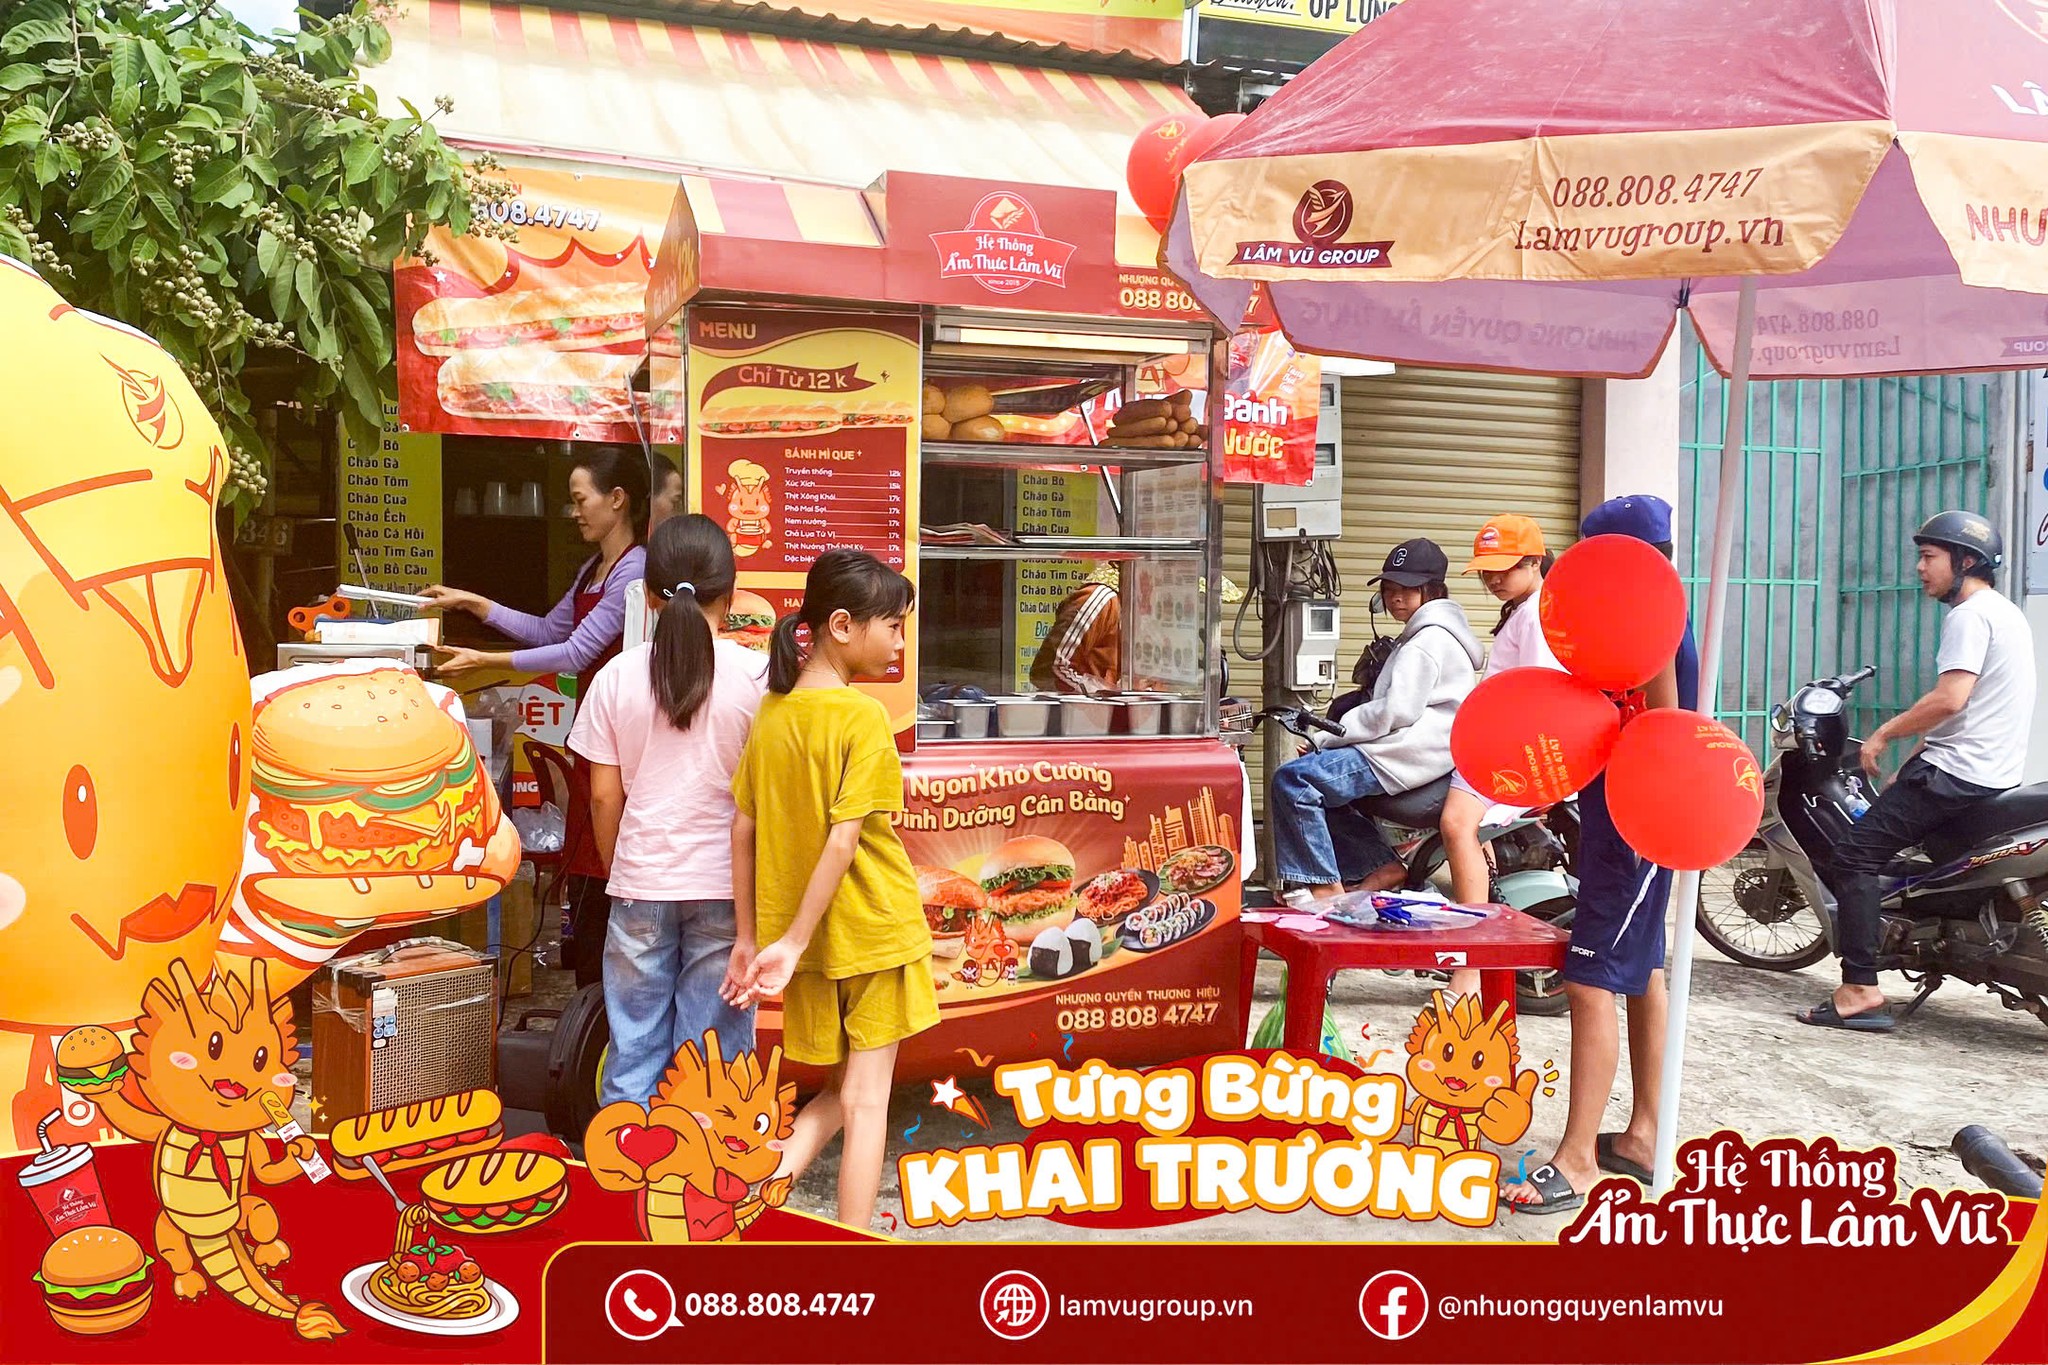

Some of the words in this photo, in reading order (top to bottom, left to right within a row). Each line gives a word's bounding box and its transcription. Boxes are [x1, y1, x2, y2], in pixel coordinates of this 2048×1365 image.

[1553, 167, 1764, 208] 088.808.4747
[1514, 216, 1785, 257] Lamvugroup.vn
[976, 234, 995, 251] Hệ
[997, 237, 1034, 257] Thống
[1243, 243, 1281, 262] LÂM
[1289, 246, 1315, 264] VŨ
[1318, 248, 1380, 265] GROUP
[973, 253, 1008, 273] Thực
[1009, 257, 1042, 275] Lâm
[1043, 260, 1063, 279] Vũ
[1120, 288, 1162, 309] 088
[700, 320, 757, 339] MENU
[738, 365, 772, 385] Chỉ
[776, 368, 804, 388] Từ
[785, 447, 816, 460] BÁNH
[818, 448, 830, 460] MÌ
[832, 450, 855, 461] QUE
[348, 456, 378, 468] Cháo
[384, 456, 399, 469] Gà
[348, 474, 378, 486] Cháo
[384, 475, 409, 487] Tôm
[1024, 475, 1048, 486] Cháo
[1052, 476, 1065, 486] Bò
[348, 492, 378, 504] Cháo
[384, 493, 407, 505] Cua
[1023, 490, 1048, 502] Cháo
[1052, 491, 1064, 502] Gà
[348, 509, 378, 522] Cháo
[384, 507, 406, 523] Ếch
[1023, 506, 1047, 518] Cháo
[1051, 507, 1071, 518] Tôm
[384, 527, 399, 539] Cá
[404, 527, 424, 540] Hồi
[1022, 522, 1047, 533] Cháo
[1051, 523, 1070, 534] Cua
[384, 545, 406, 557] Tim
[410, 546, 434, 559] Gan
[1393, 548, 1408, 567] C
[384, 562, 400, 575] Bồ
[404, 563, 428, 575] Câu
[1022, 569, 1046, 580] Cháo
[1049, 569, 1067, 580] Tim
[1021, 584, 1046, 595] Cháo
[1050, 584, 1063, 595] Bồ
[1020, 602, 1036, 613] Cháo
[1038, 602, 1050, 613] Cút
[796, 629, 808, 637] ger
[910, 773, 977, 803] Ngon
[943, 803, 1016, 829] Dưỡng
[1020, 794, 1065, 816] Cân
[1069, 789, 1125, 821] Bằng
[1056, 992, 1101, 1006] NHƯỢNG
[1105, 988, 1142, 1003] QUYỀN
[1147, 988, 1191, 1000] THƯƠNG
[1196, 985, 1220, 1001] HIỆU
[1057, 1008, 1105, 1031] 088
[1111, 1006, 1158, 1028] 808
[1163, 1003, 1219, 1025] 4747
